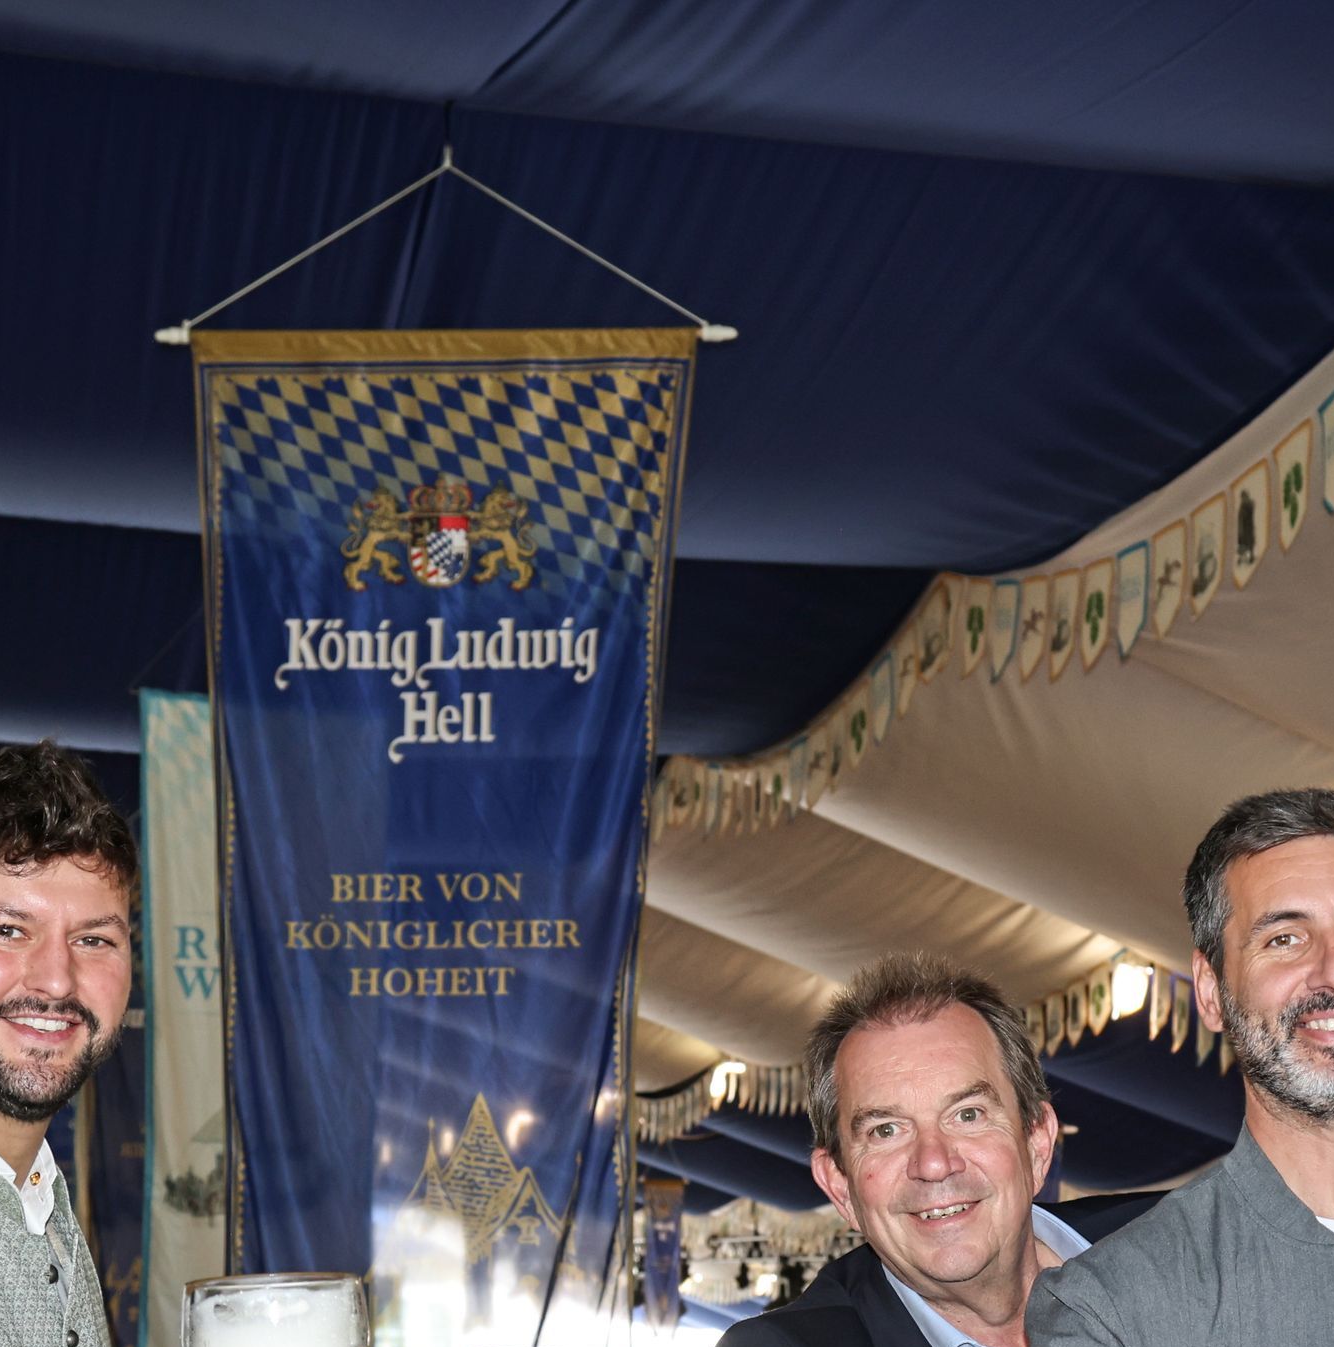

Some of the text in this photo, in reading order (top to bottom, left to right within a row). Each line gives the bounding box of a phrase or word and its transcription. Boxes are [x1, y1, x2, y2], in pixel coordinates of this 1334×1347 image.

[274, 617, 599, 690] König Ludwig
[388, 691, 496, 764] Hell
[331, 873, 523, 903] BIER VON
[173, 925, 220, 960] R
[284, 913, 581, 949] KÖNIGLICHER
[349, 967, 515, 996] HOHEIT
